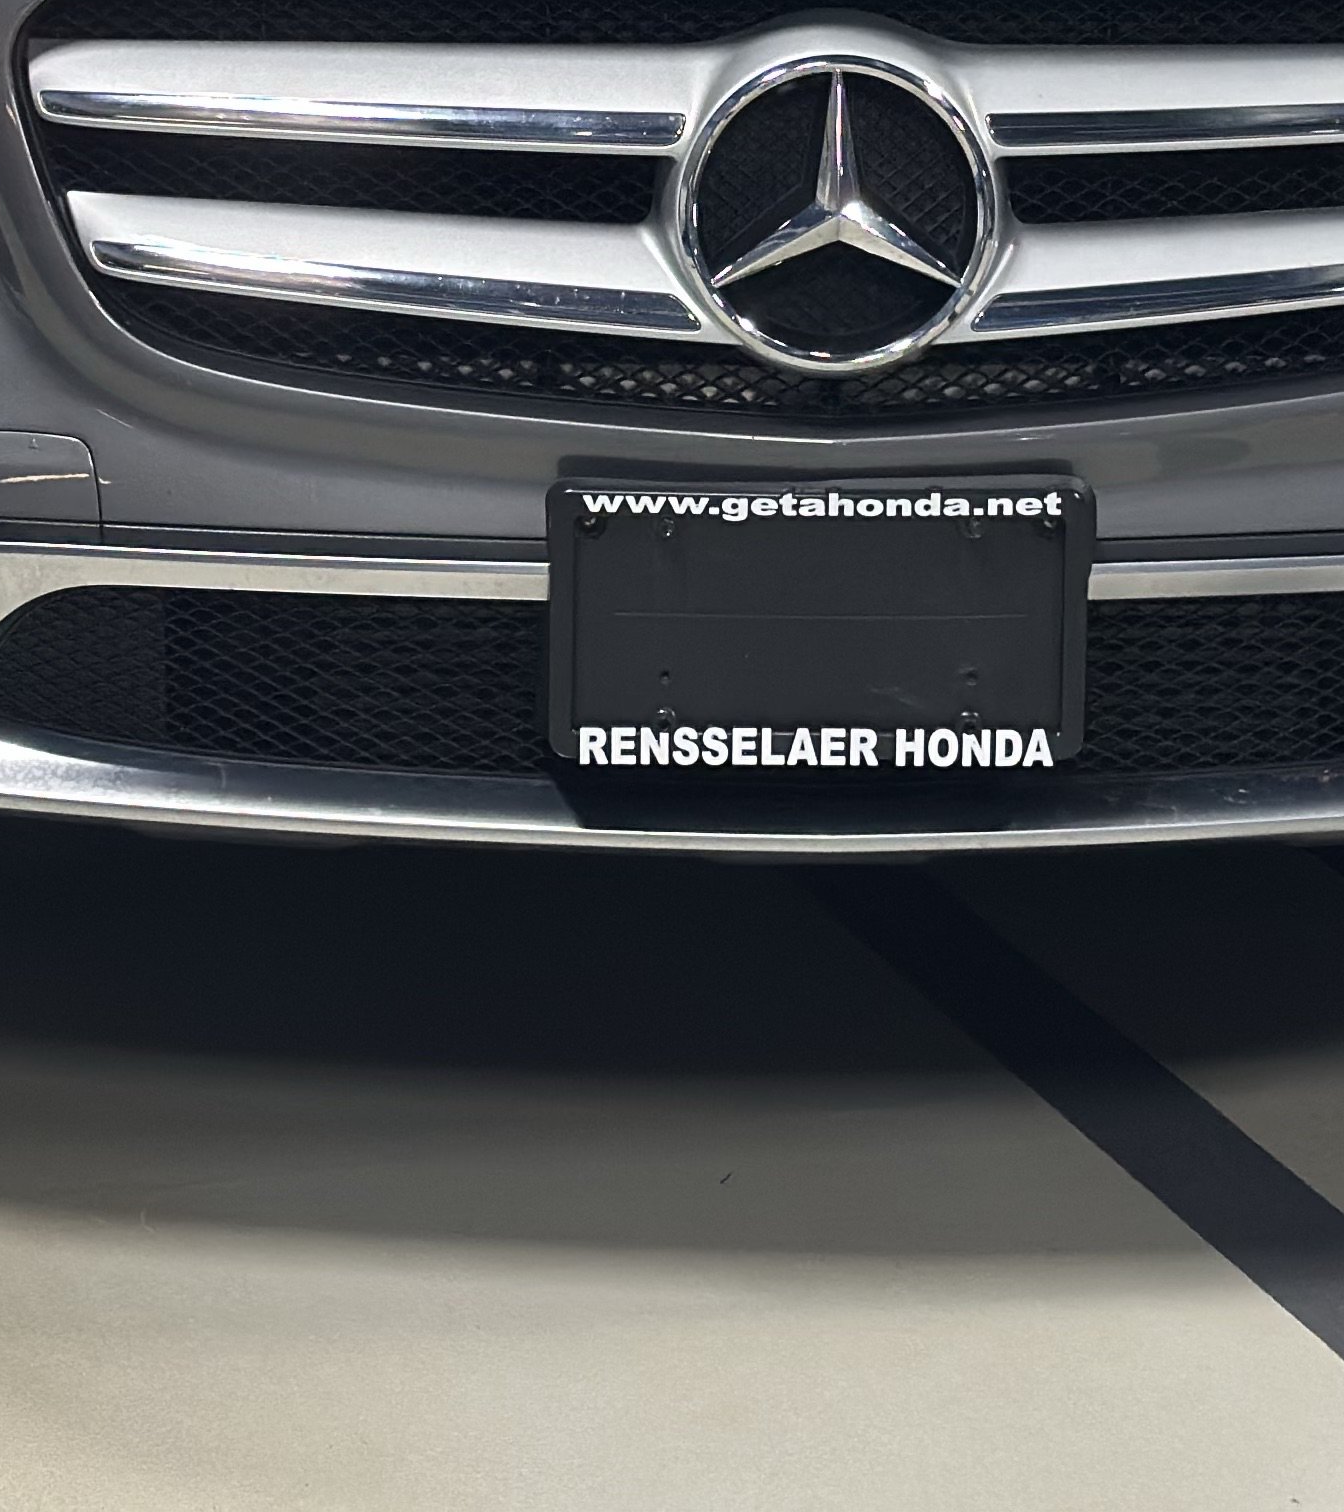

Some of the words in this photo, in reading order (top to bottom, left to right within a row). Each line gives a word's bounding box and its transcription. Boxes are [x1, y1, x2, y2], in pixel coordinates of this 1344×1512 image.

[582, 492, 1062, 522] www.getahonda.net
[579, 726, 879, 767] RENSSELAER
[895, 728, 1054, 768] HONDA
